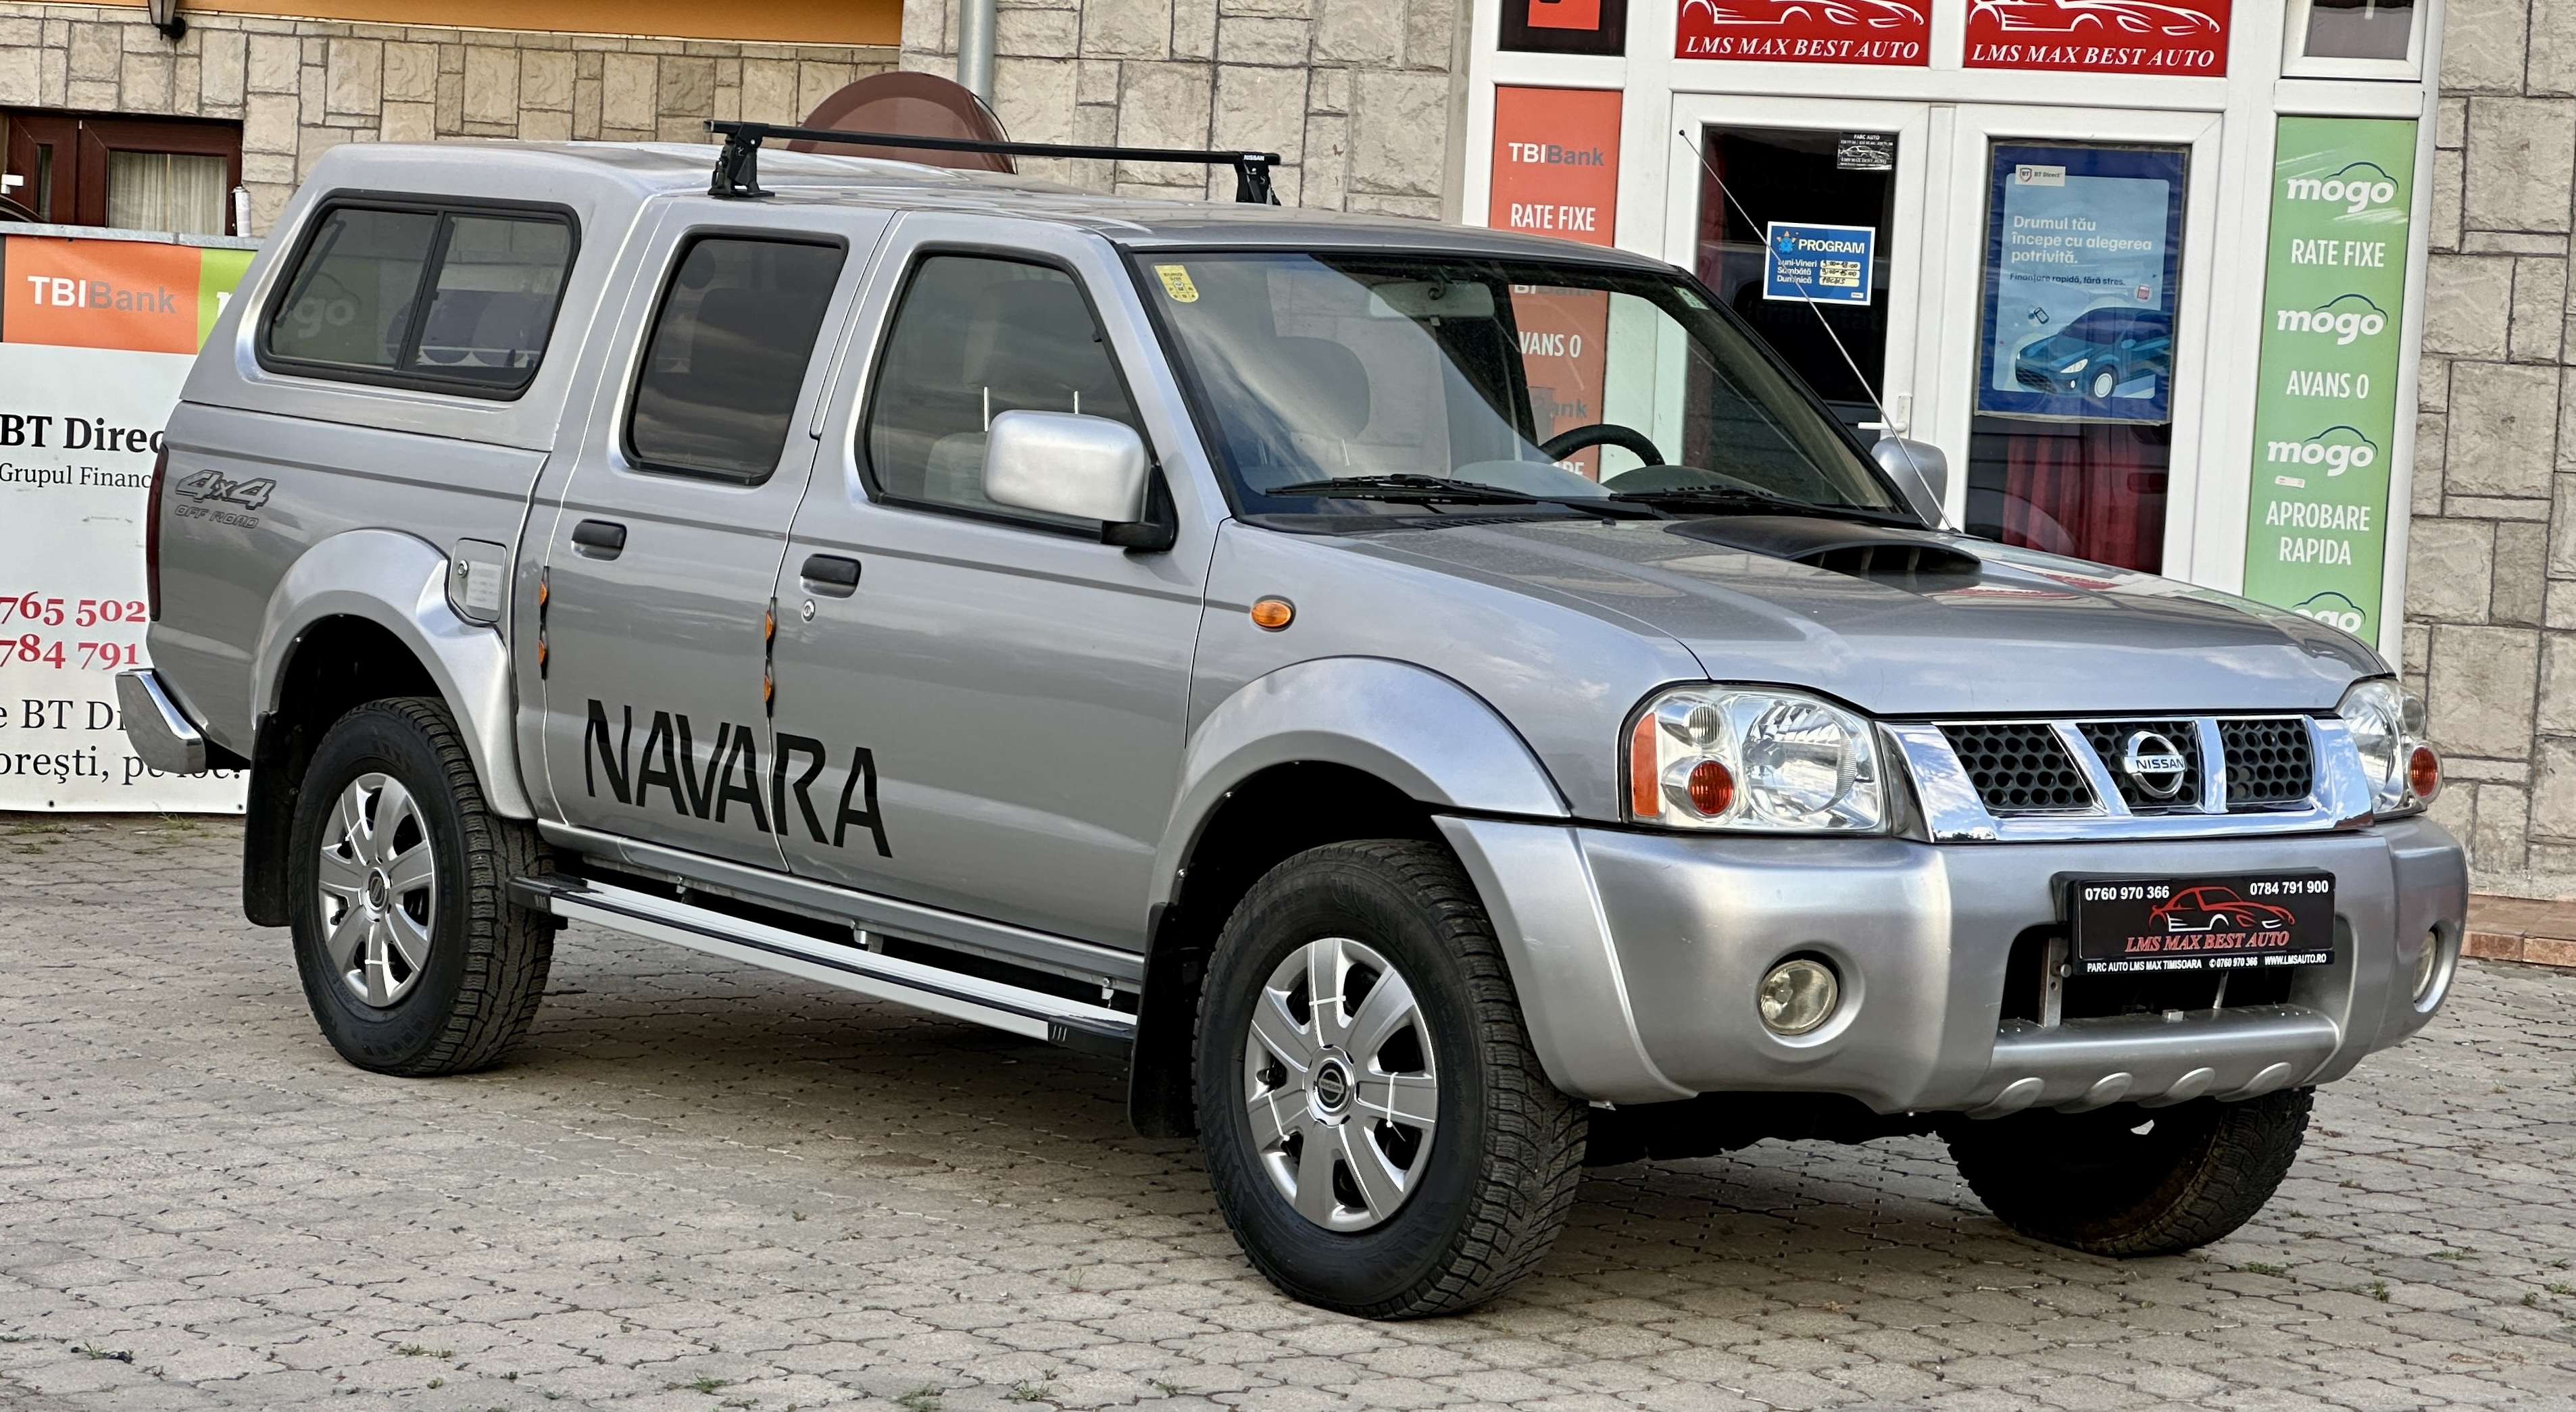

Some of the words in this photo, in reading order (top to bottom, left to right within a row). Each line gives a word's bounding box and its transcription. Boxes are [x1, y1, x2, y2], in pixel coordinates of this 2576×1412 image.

[1685, 36, 1733, 54] LMS
[1737, 38, 1791, 55] MAX
[1792, 39, 1854, 57] BEST
[1854, 41, 1920, 59] AUTO
[1971, 44, 2023, 62] LMS
[2025, 45, 2083, 64] MAX
[2083, 47, 2147, 66] BEST
[2148, 49, 2214, 68] AUTO
[1508, 143, 1604, 166] TBIBank
[2287, 178, 2394, 213] mogo
[1510, 203, 1554, 229] RATE
[1558, 205, 1596, 231] FIXE
[2013, 215, 2068, 230] Drumul
[2072, 218, 2096, 231] tău
[1798, 238, 1865, 254] PROGRAM
[2011, 232, 2062, 249] începe
[2065, 237, 2083, 247] cu
[2086, 236, 2152, 251] alegerea
[2291, 238, 2338, 266] RATE
[2344, 241, 2385, 268] FIXE
[2011, 250, 2078, 263] potrivită.
[28, 276, 176, 313] TBIBank
[2277, 310, 2384, 345] mogo
[2286, 370, 2351, 398] AVANS
[0, 414, 52, 447] BT
[2268, 440, 2373, 476] mogo
[0, 463, 72, 487] Grupul
[175, 470, 276, 510] 4x4
[175, 505, 209, 519] OFF
[209, 511, 259, 528] ROAD
[2265, 501, 2371, 531] APROBARE
[2279, 537, 2352, 565] RAPIDA
[0, 591, 64, 626] 765
[76, 599, 145, 627] 502
[0, 634, 66, 669] 784
[78, 642, 139, 670] 791
[21, 699, 73, 730] BT
[2135, 759, 2183, 769] NISSAN
[585, 699, 893, 858] NAVARA
[2085, 886, 2117, 901] 0760
[2120, 886, 2144, 900] 970
[2146, 886, 2170, 899] 366
[2250, 882, 2279, 895] 0784
[2282, 881, 2303, 894] 791
[2306, 880, 2329, 893] 900
[2125, 936, 2161, 953] LMS
[2163, 934, 2202, 951] MAX
[2203, 932, 2246, 950] BEST
[2246, 930, 2289, 947] AUTO
[2087, 963, 2107, 973] PARC
[2108, 962, 2129, 972] AUTO
[2129, 961, 2145, 971] LMS
[2146, 961, 2162, 970] MAX
[2163, 959, 2202, 969] TIMISOARA
[2216, 958, 2232, 967] 0760
[2233, 957, 2245, 967] 970
[2246, 957, 2258, 966] 366
[2264, 953, 2327, 965] WWW.LMSAUTO.RO
